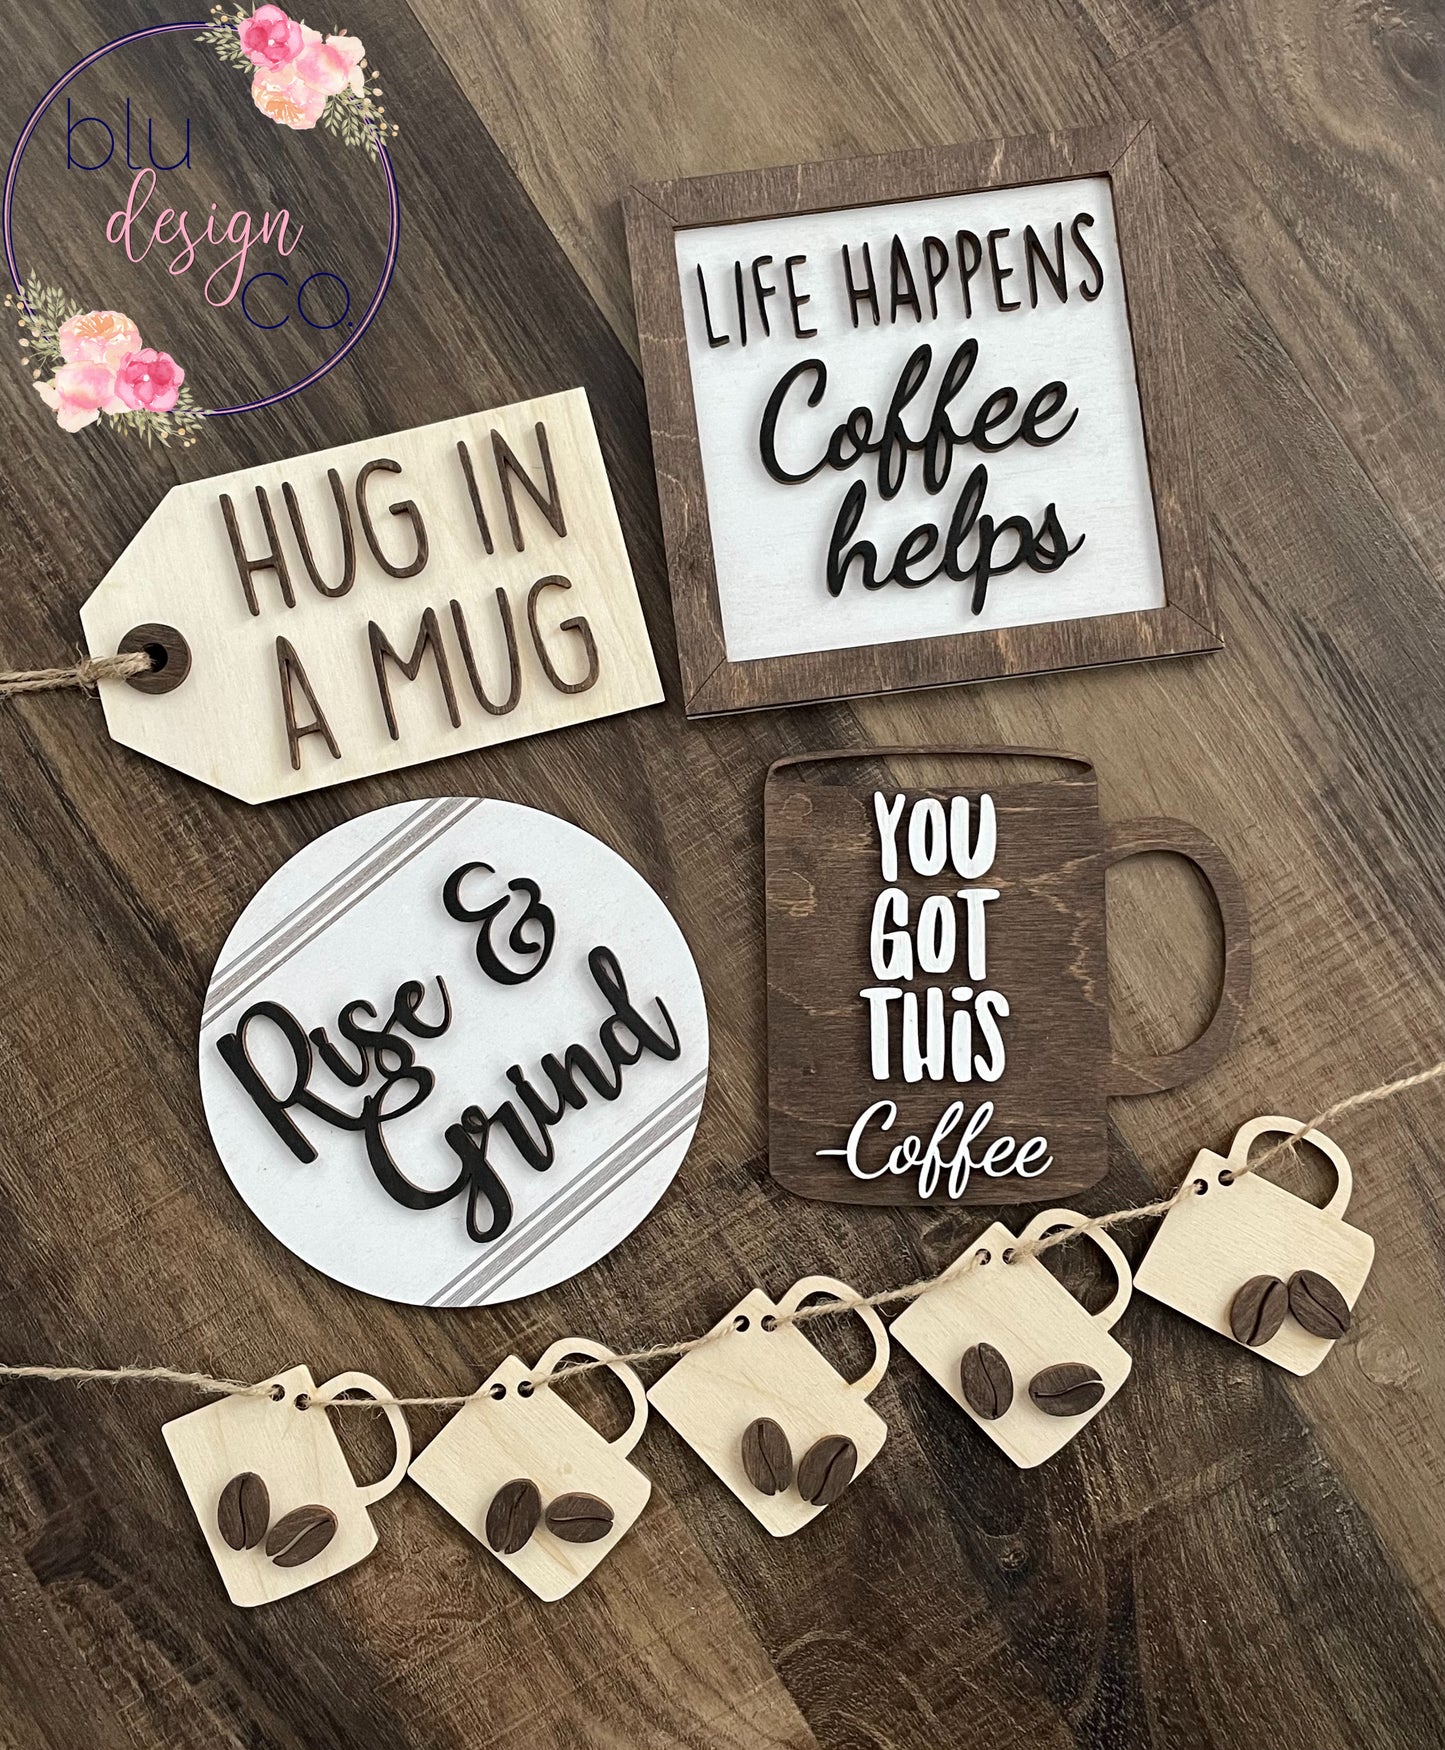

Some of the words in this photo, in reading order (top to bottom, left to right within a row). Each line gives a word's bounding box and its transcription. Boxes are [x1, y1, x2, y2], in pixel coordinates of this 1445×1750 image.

[696, 254, 818, 349] LIFE
[841, 211, 1105, 329] HAPPENS
[759, 337, 1080, 501] Coffee
[218, 457, 429, 617] HUG
[456, 421, 568, 555] IN
[825, 463, 1087, 616] helps
[275, 635, 342, 771] A
[367, 575, 601, 741] MUG
[873, 791, 998, 883] YOU
[442, 861, 557, 986] &
[869, 886, 1001, 982] GOT
[361, 945, 682, 1244] Grind
